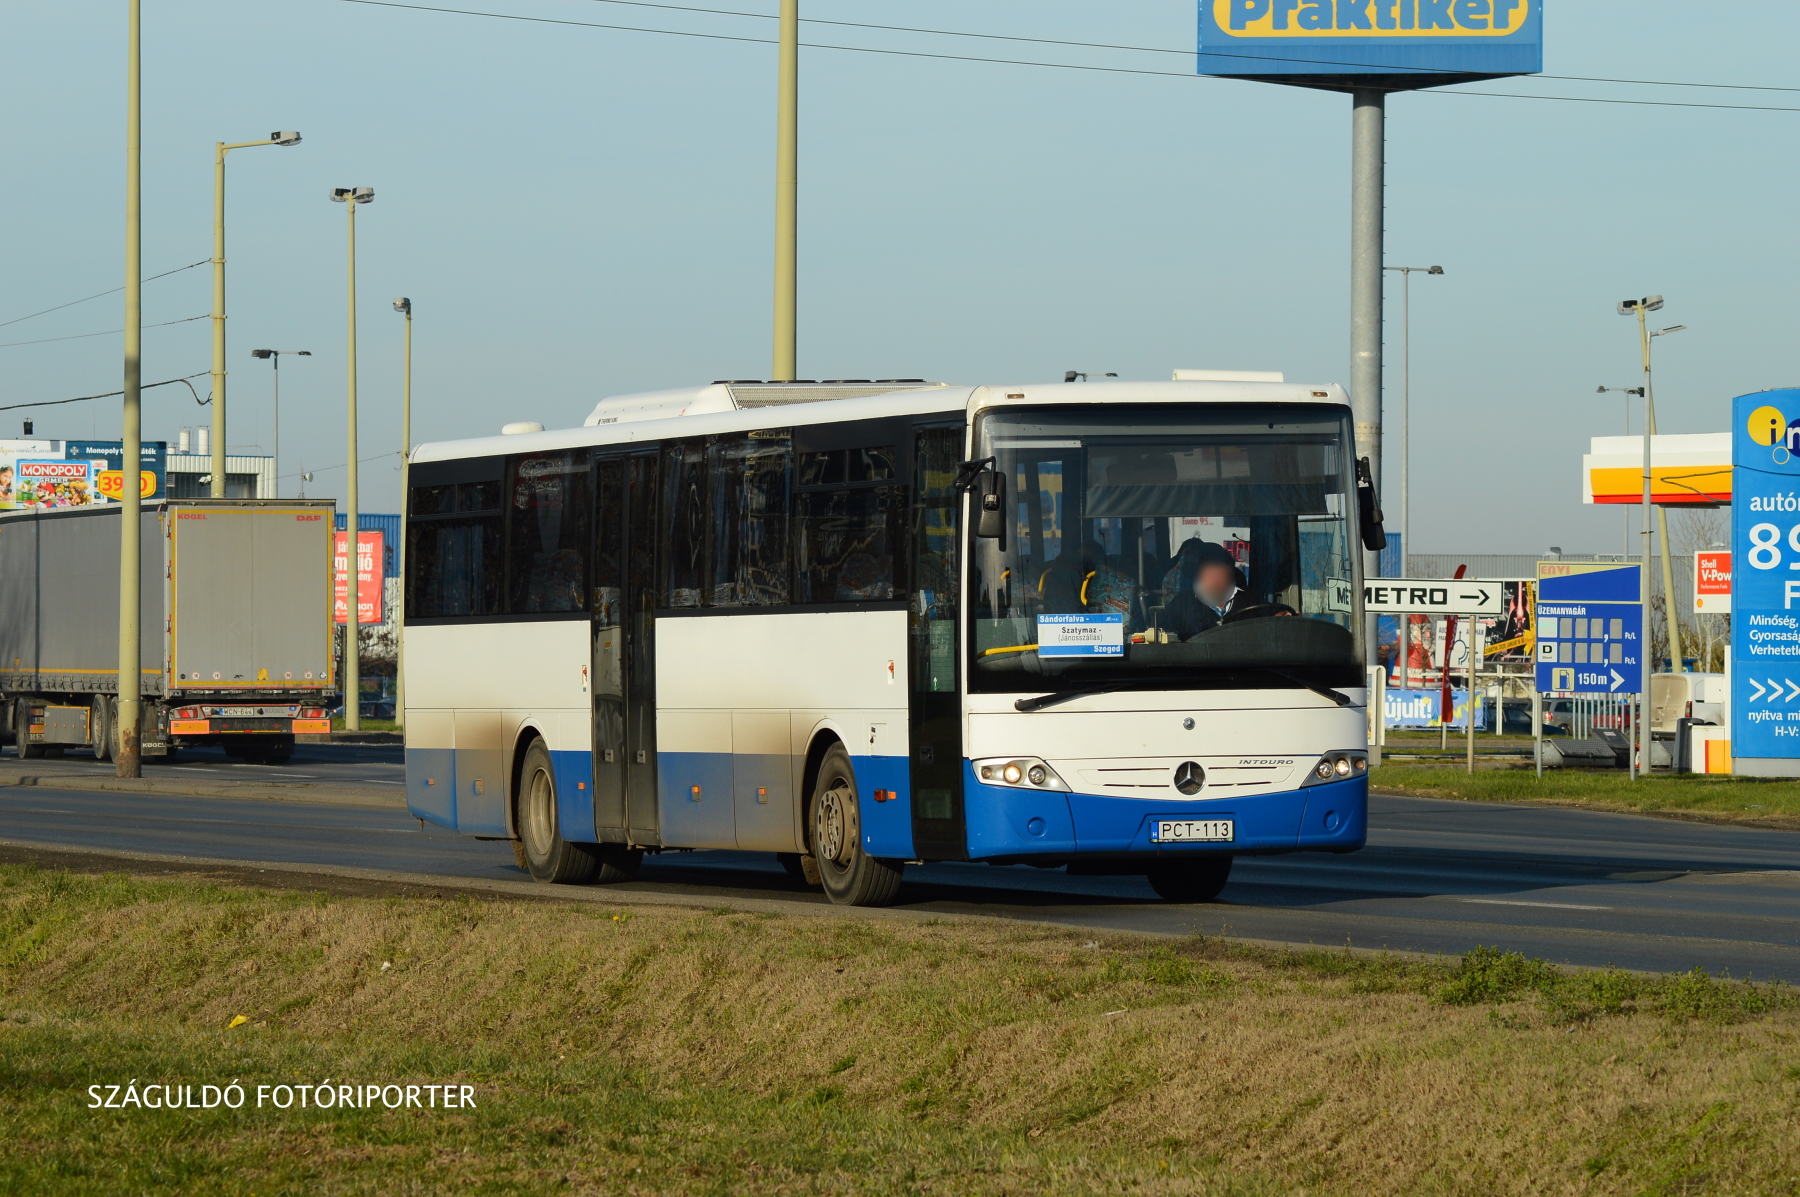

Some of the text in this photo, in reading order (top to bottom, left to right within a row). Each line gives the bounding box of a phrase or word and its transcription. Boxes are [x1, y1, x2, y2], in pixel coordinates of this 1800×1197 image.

[1229, 0, 1518, 30] Praktiker
[86, 447, 119, 455] Monopoly
[22, 465, 86, 476] MONOPOLY
[102, 476, 148, 492] 390
[1701, 559, 1716, 569] Shell
[1538, 605, 1586, 615] ÜZEMANYAGÁR
[1039, 615, 1084, 623] Sándorfalva
[1749, 614, 1798, 629] Minőség,
[1061, 627, 1097, 635] Szatymaz
[1058, 634, 1103, 642] (Jánosszállás)
[1094, 645, 1120, 653] Szeged
[1543, 645, 1552, 653] D
[1578, 673, 1607, 685] 150m
[1748, 710, 1783, 723] nyitva
[1775, 726, 1798, 736] H-V:
[1162, 822, 1229, 837] PCT-113
